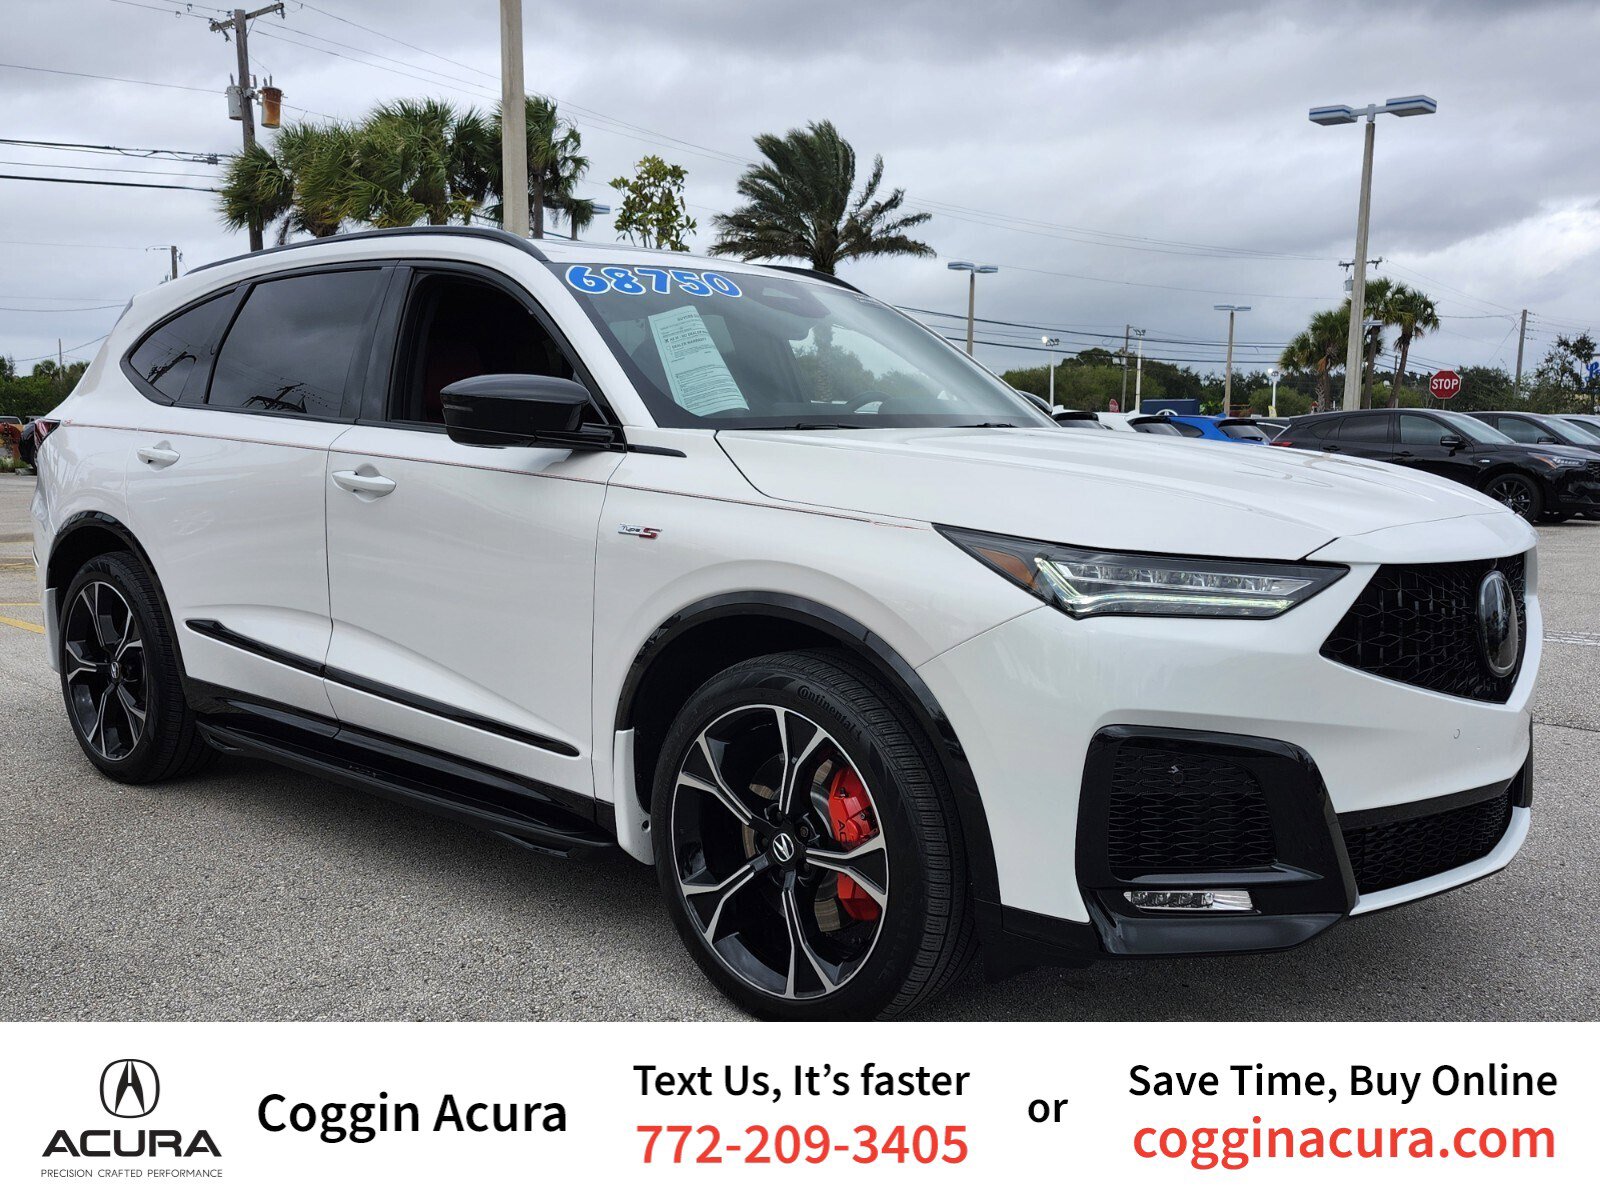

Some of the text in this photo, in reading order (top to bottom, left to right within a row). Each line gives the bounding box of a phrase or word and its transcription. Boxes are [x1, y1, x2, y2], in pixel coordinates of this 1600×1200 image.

[565, 265, 743, 298] 68750
[1431, 378, 1459, 390] STOP
[639, 527, 663, 539] S
[797, 685, 857, 733] Continental
